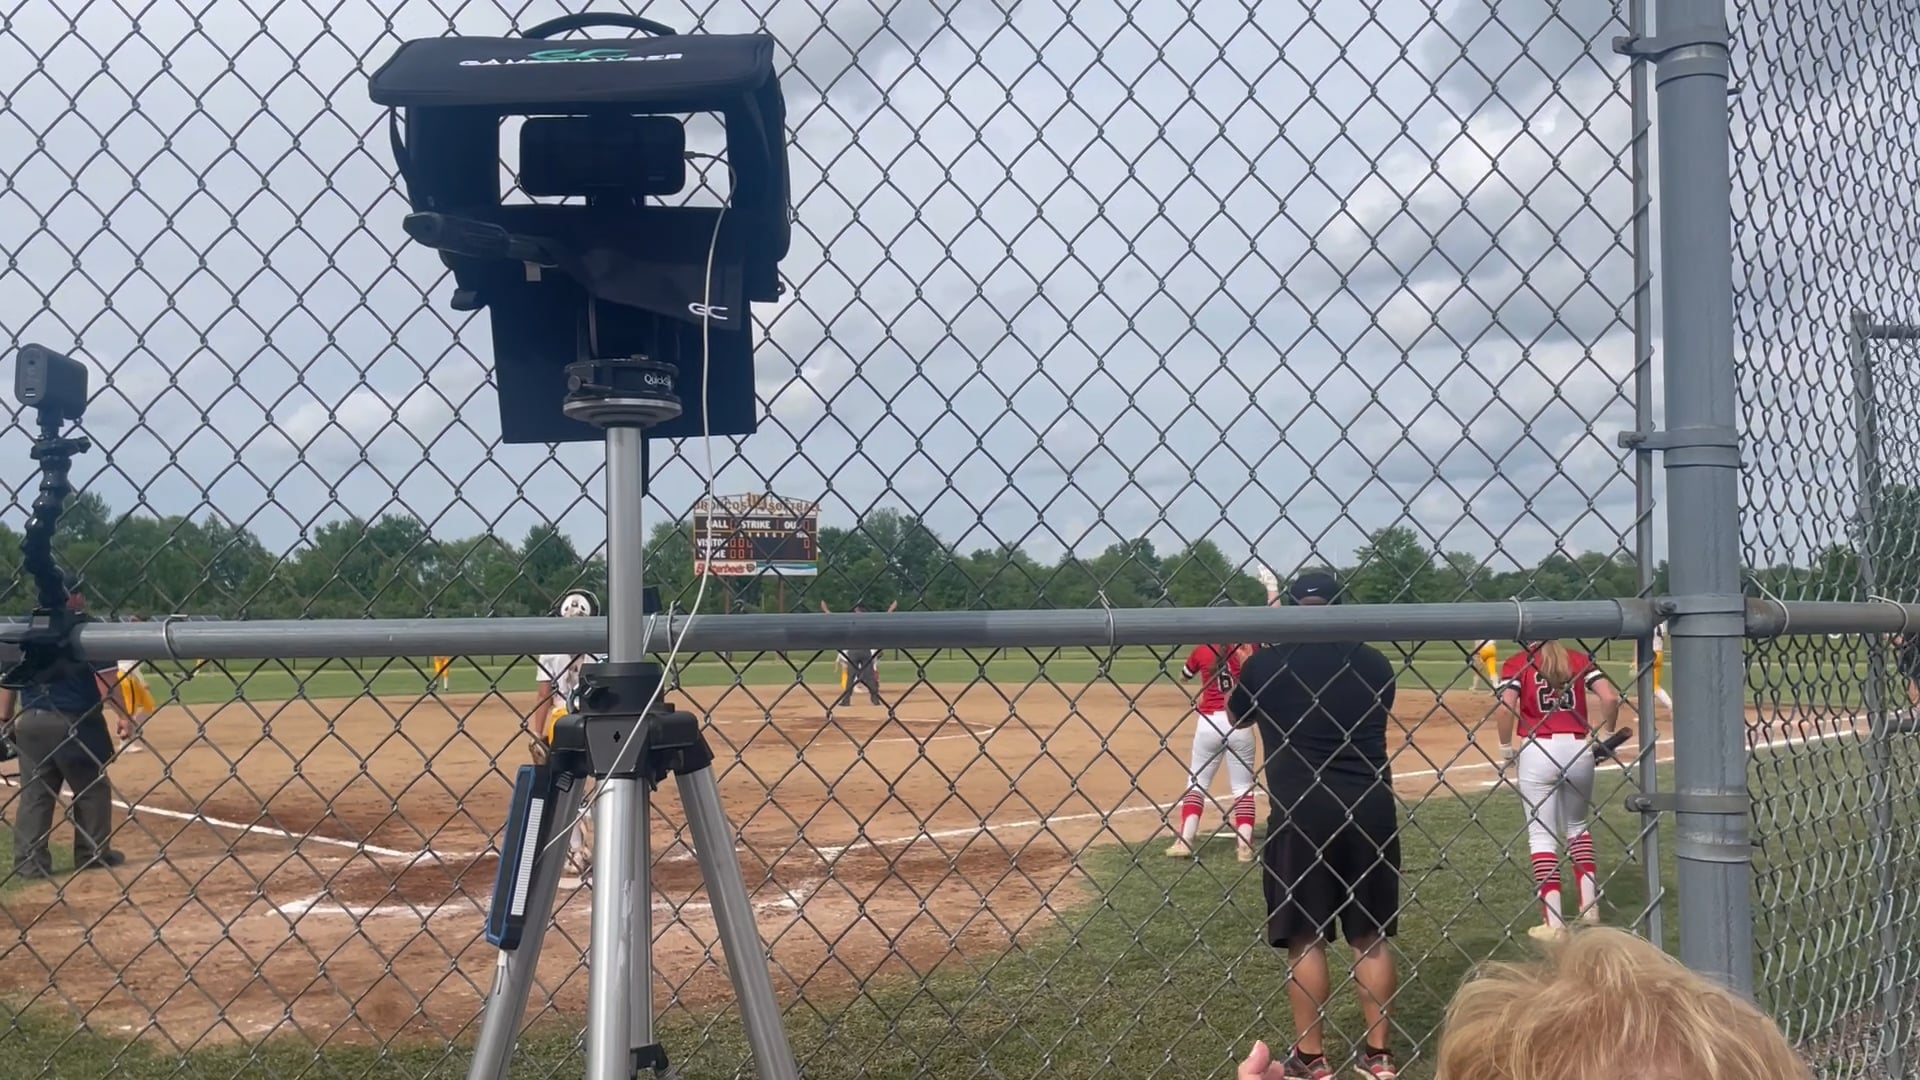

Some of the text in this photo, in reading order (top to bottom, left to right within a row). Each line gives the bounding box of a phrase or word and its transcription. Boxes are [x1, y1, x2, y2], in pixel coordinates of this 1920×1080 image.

[688, 302, 728, 320] GC
[769, 501, 823, 512] SOTBALL
[741, 520, 771, 529] STRIKE
[784, 520, 800, 530] OU
